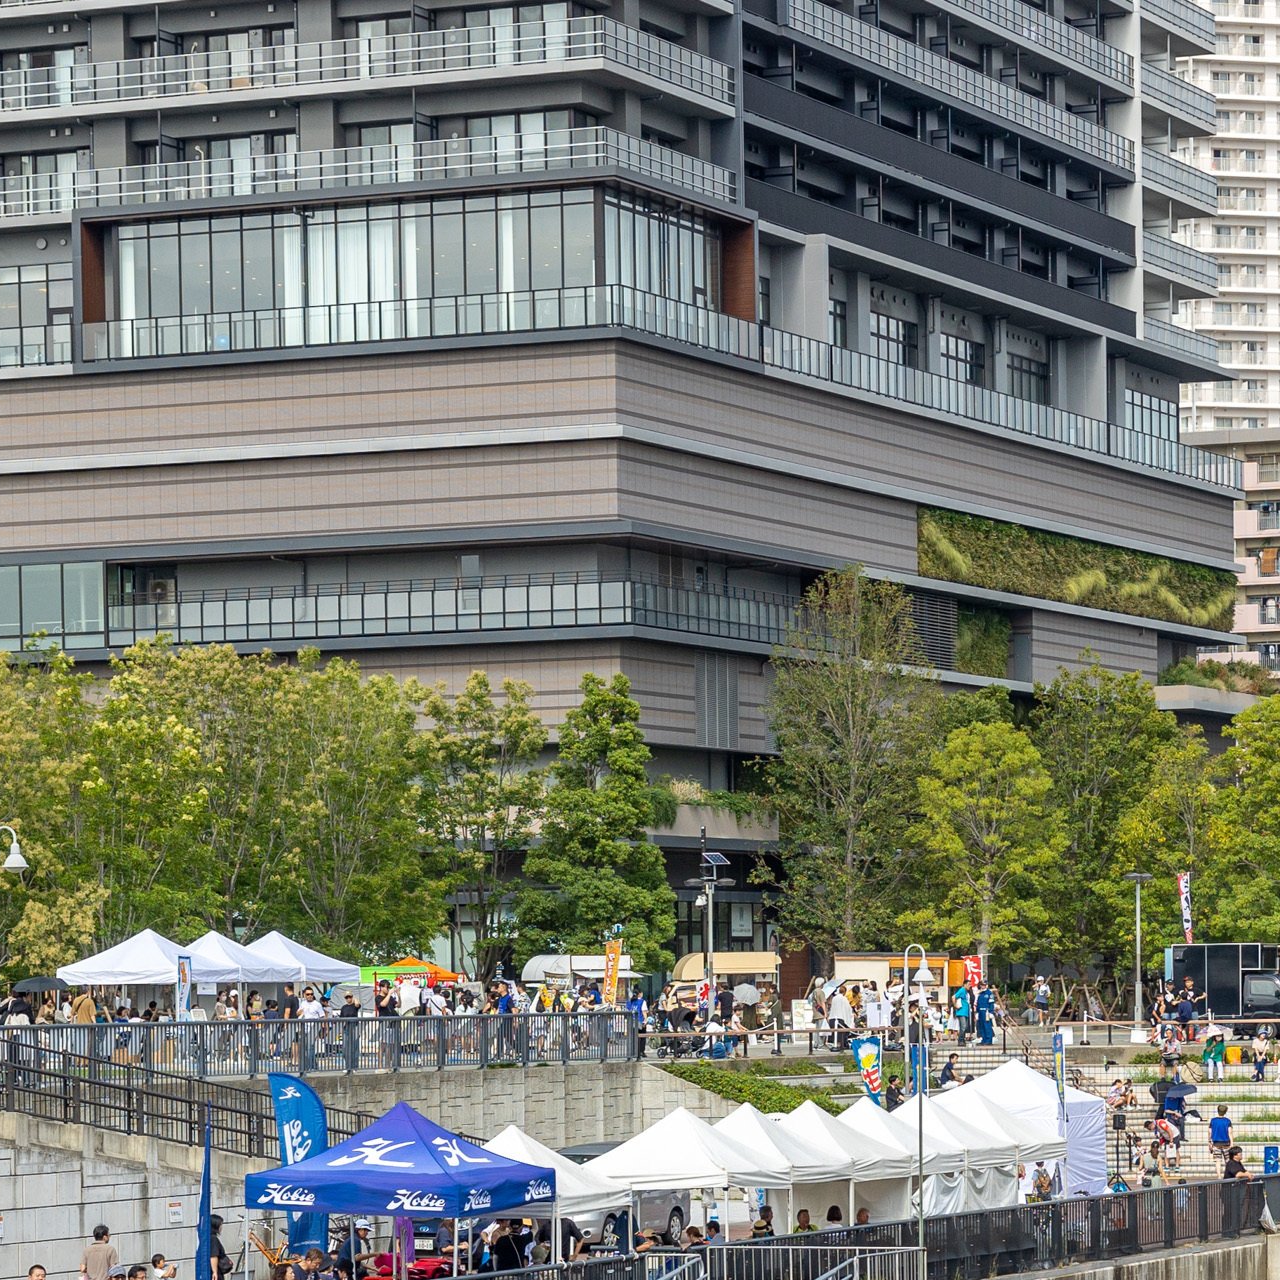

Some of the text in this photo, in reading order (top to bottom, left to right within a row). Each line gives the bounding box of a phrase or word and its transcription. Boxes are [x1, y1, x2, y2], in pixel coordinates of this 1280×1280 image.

[257, 1183, 316, 1206] Hobie
[386, 1189, 446, 1211] Hobie
[464, 1188, 492, 1211] Hobie
[524, 1179, 552, 1201] Hobie
